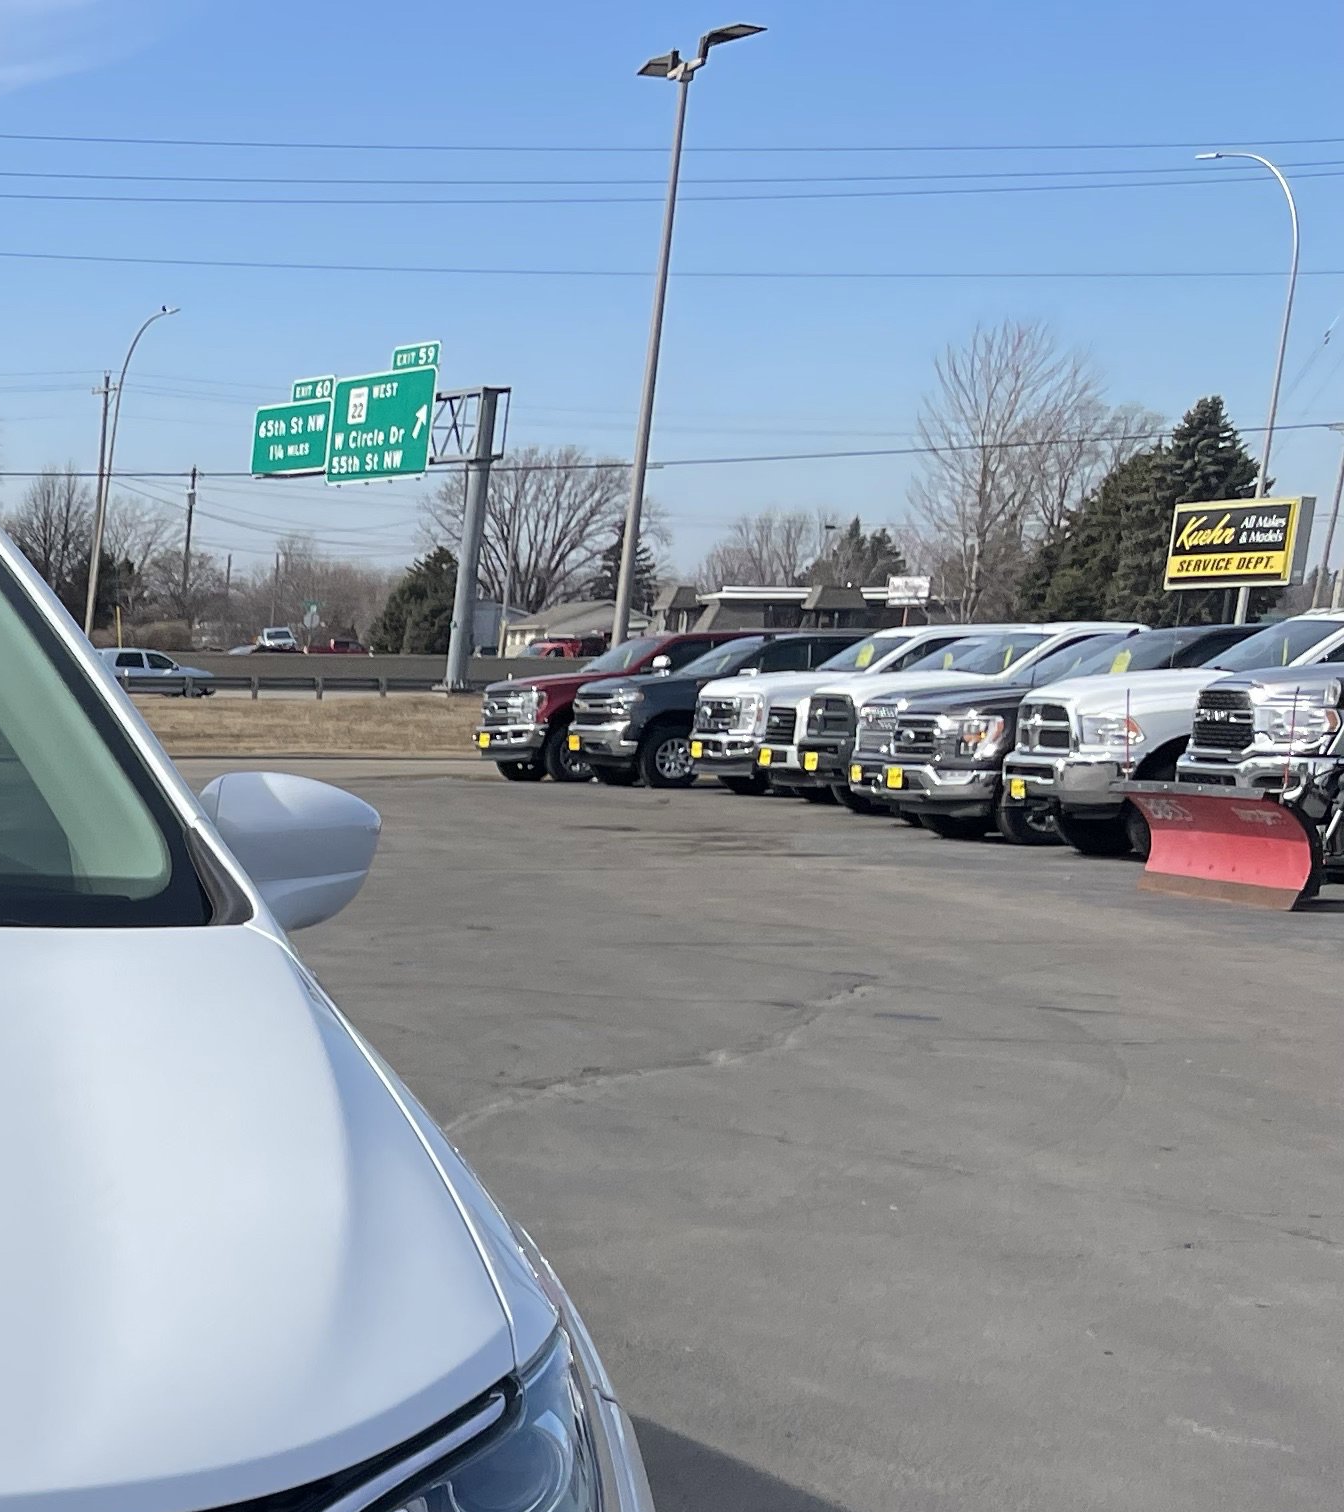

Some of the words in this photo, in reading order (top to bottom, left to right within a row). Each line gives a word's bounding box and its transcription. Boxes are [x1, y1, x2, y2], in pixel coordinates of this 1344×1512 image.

[396, 352, 416, 366] EXIT
[418, 346, 435, 365] 59
[295, 385, 313, 398] EXIT
[315, 380, 331, 398] 60
[372, 382, 399, 399] WEST
[351, 402, 364, 419] 22
[258, 420, 286, 438] 65th
[290, 416, 304, 435] St
[307, 413, 326, 433] NW
[334, 432, 344, 451] W
[348, 429, 385, 449] Circle
[389, 425, 405, 445] Dr
[286, 442, 310, 456] MILES
[331, 456, 360, 474] 55th
[364, 453, 379, 472] St
[383, 450, 403, 470] NW
[1240, 514, 1257, 529] All
[1255, 514, 1287, 528] Makes
[1175, 512, 1236, 551] Kuehn
[1238, 531, 1247, 544] &
[1248, 529, 1284, 543] Models
[1176, 557, 1233, 573] SERVICE
[1236, 555, 1274, 570] DEPT.
